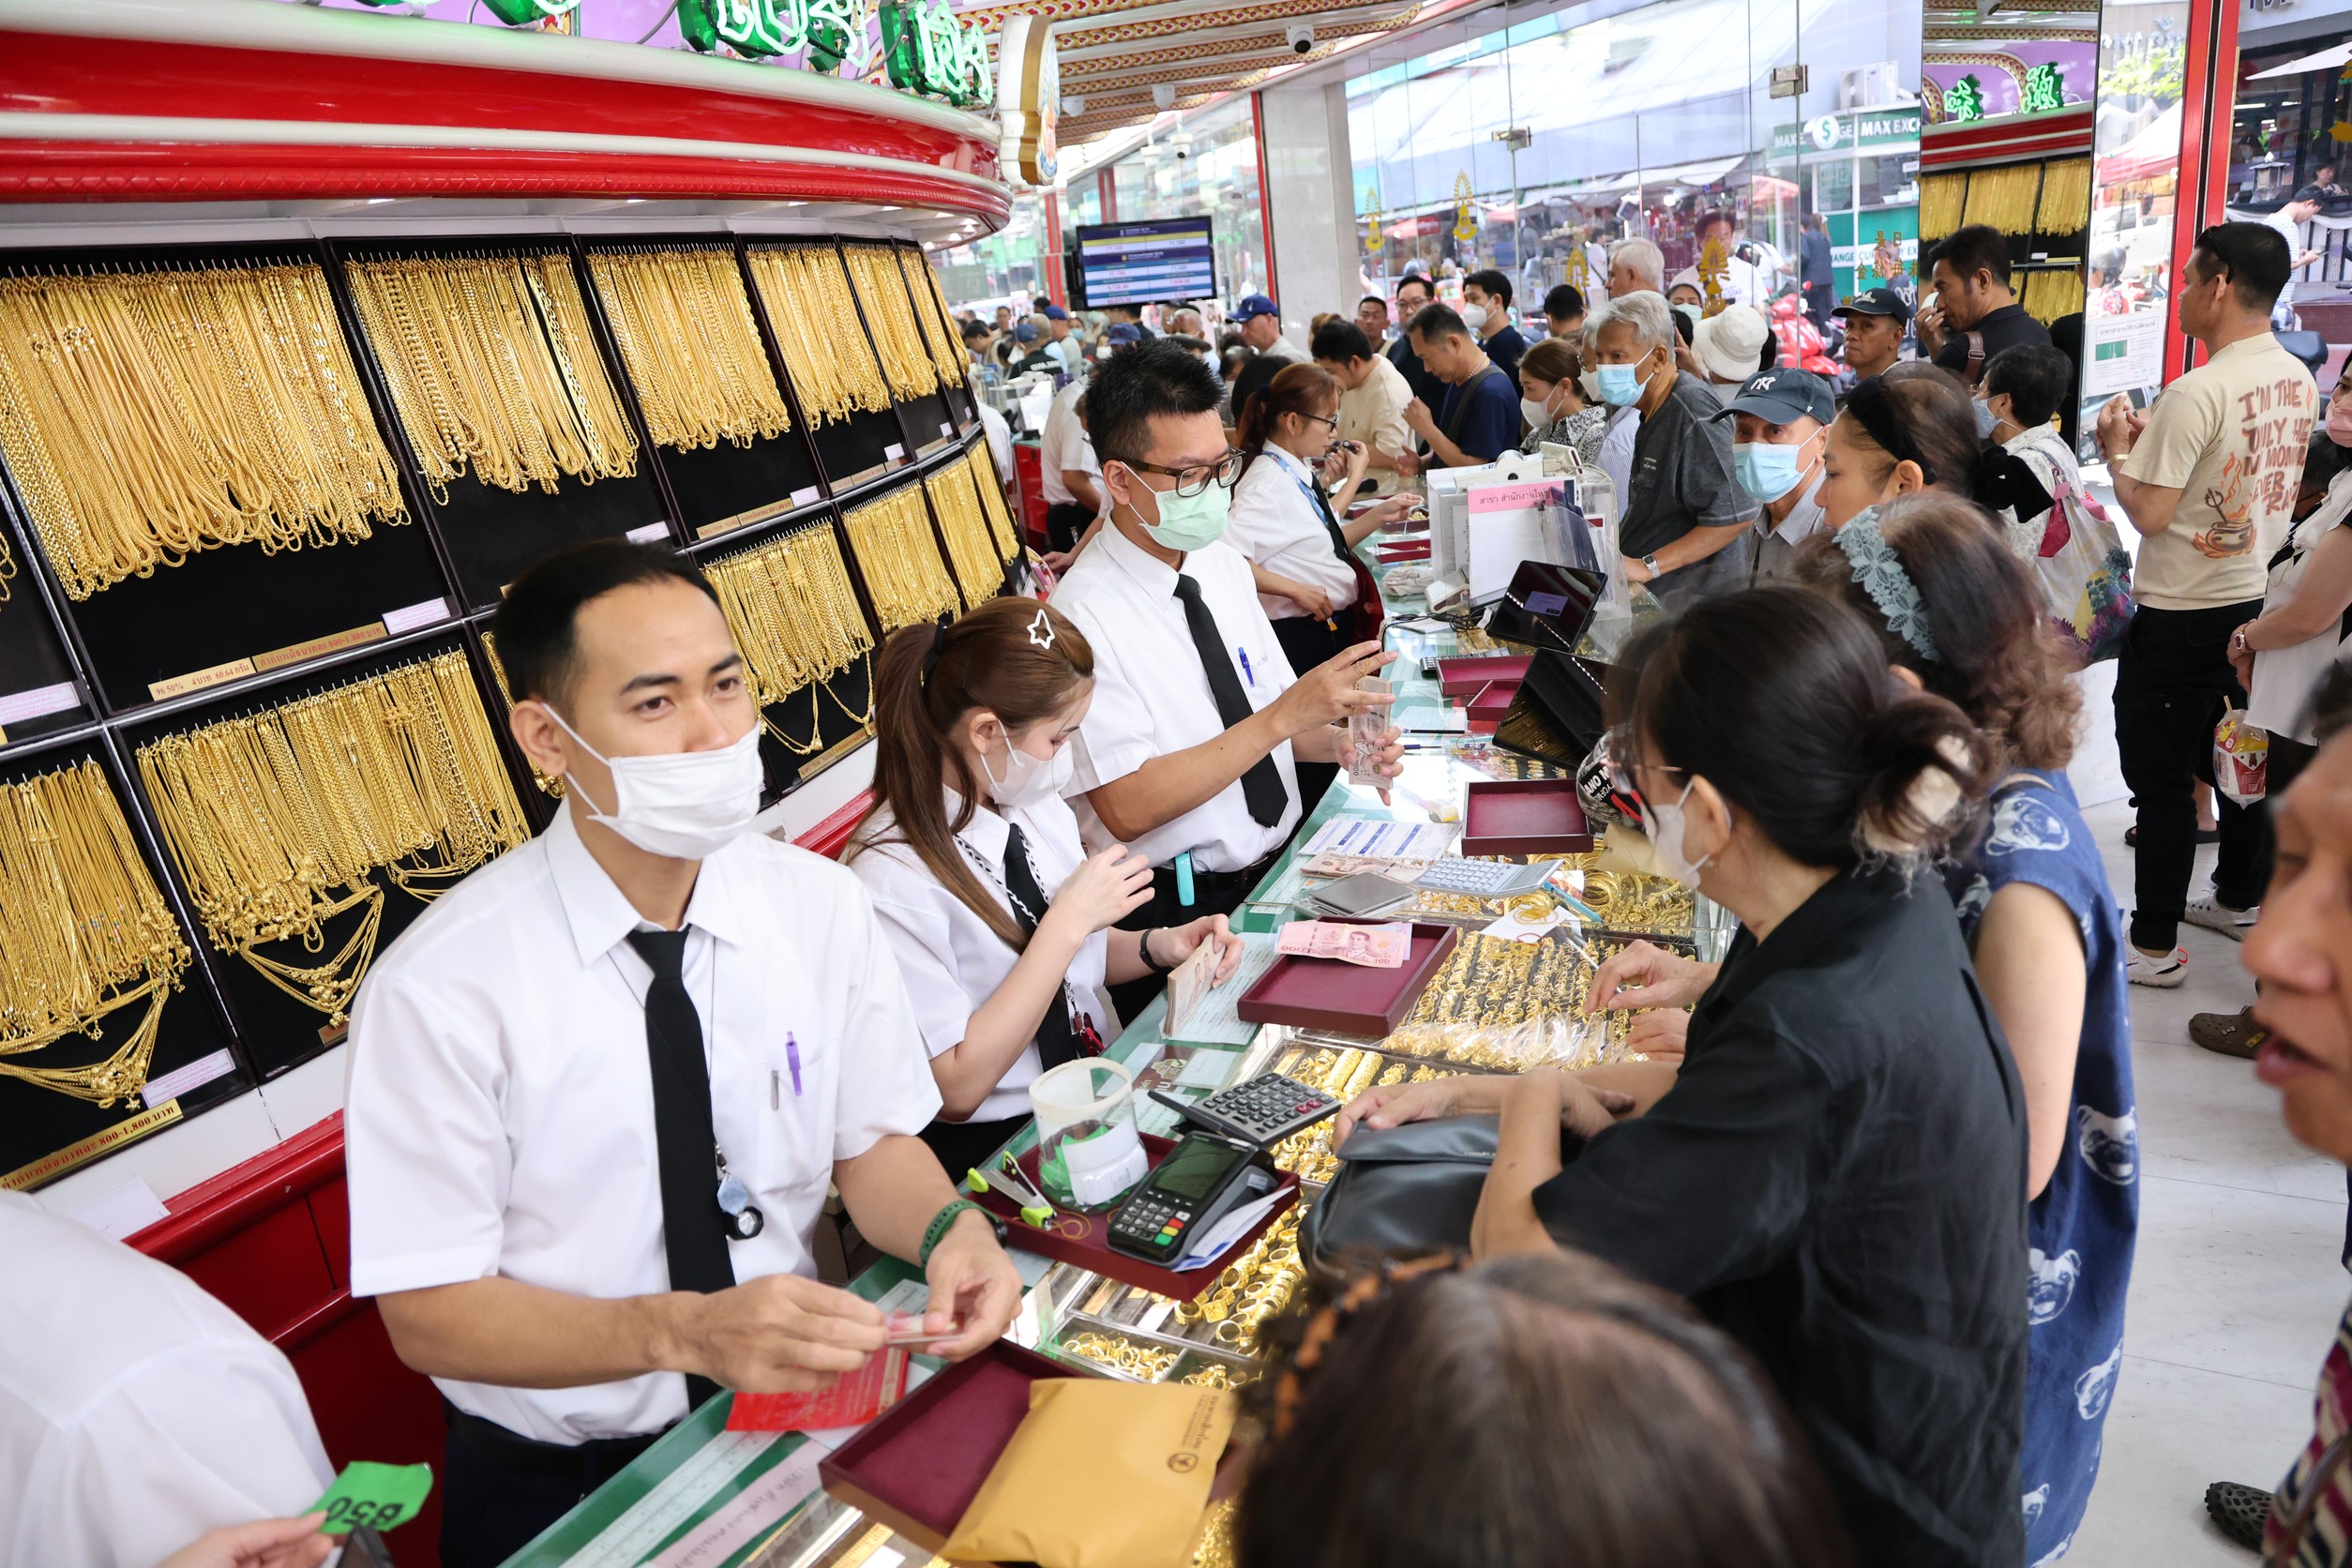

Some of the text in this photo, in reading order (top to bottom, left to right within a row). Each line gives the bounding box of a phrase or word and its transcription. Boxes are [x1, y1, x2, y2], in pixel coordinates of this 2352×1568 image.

[1861, 120, 1892, 138] MAX
[2239, 378, 2302, 422] I'M THE
[1480, 494, 1499, 505] สาขา
[366, 626, 383, 639] บาท
[216, 669, 234, 680] 60.64
[235, 662, 249, 674] กรัม
[98, 1116, 151, 1146] 800-1,800
[153, 1105, 175, 1122] บาท
